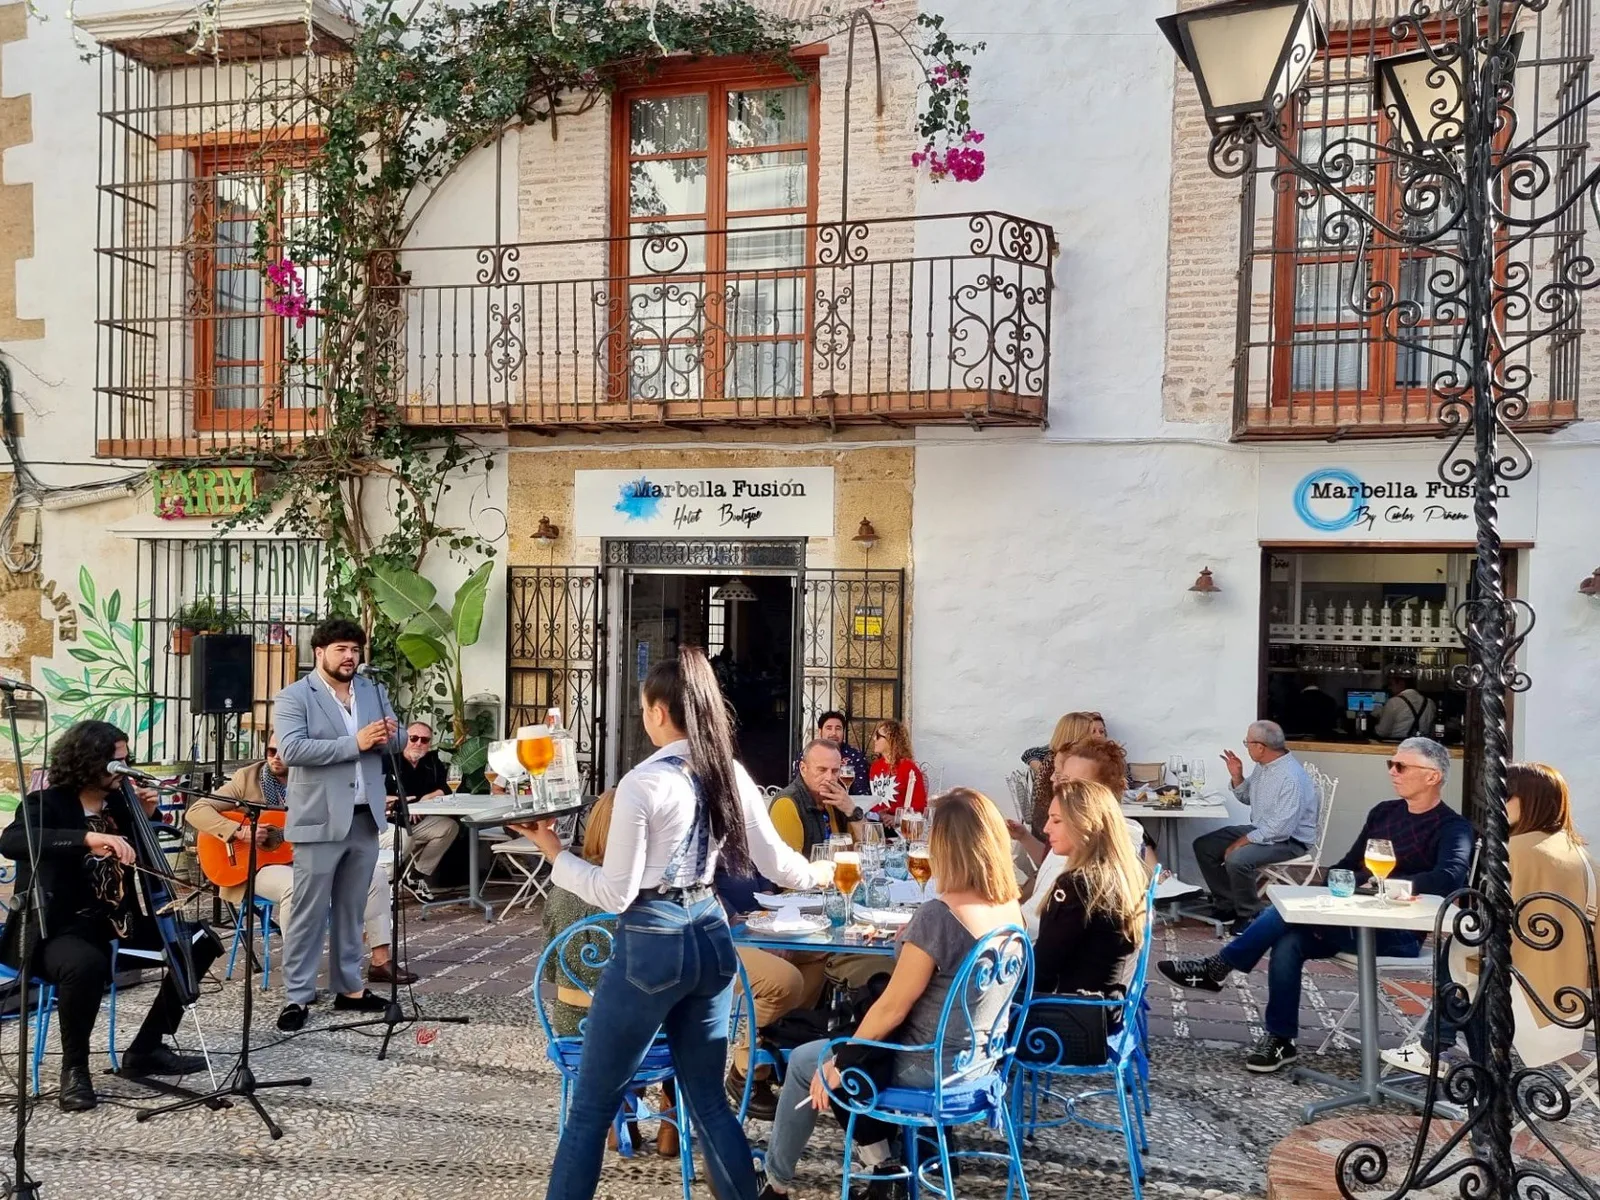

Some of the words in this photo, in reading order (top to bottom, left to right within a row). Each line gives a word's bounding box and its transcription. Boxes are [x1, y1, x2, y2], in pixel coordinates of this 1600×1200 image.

[152, 468, 255, 516] FARM
[632, 480, 727, 498] Marbella
[732, 478, 807, 497] Fusión
[1311, 482, 1418, 499] Marbella
[1425, 481, 1510, 499] Fusin
[673, 504, 703, 530] Hotel
[1352, 505, 1377, 532] By
[194, 543, 240, 596] THE
[254, 544, 320, 597] FARM
